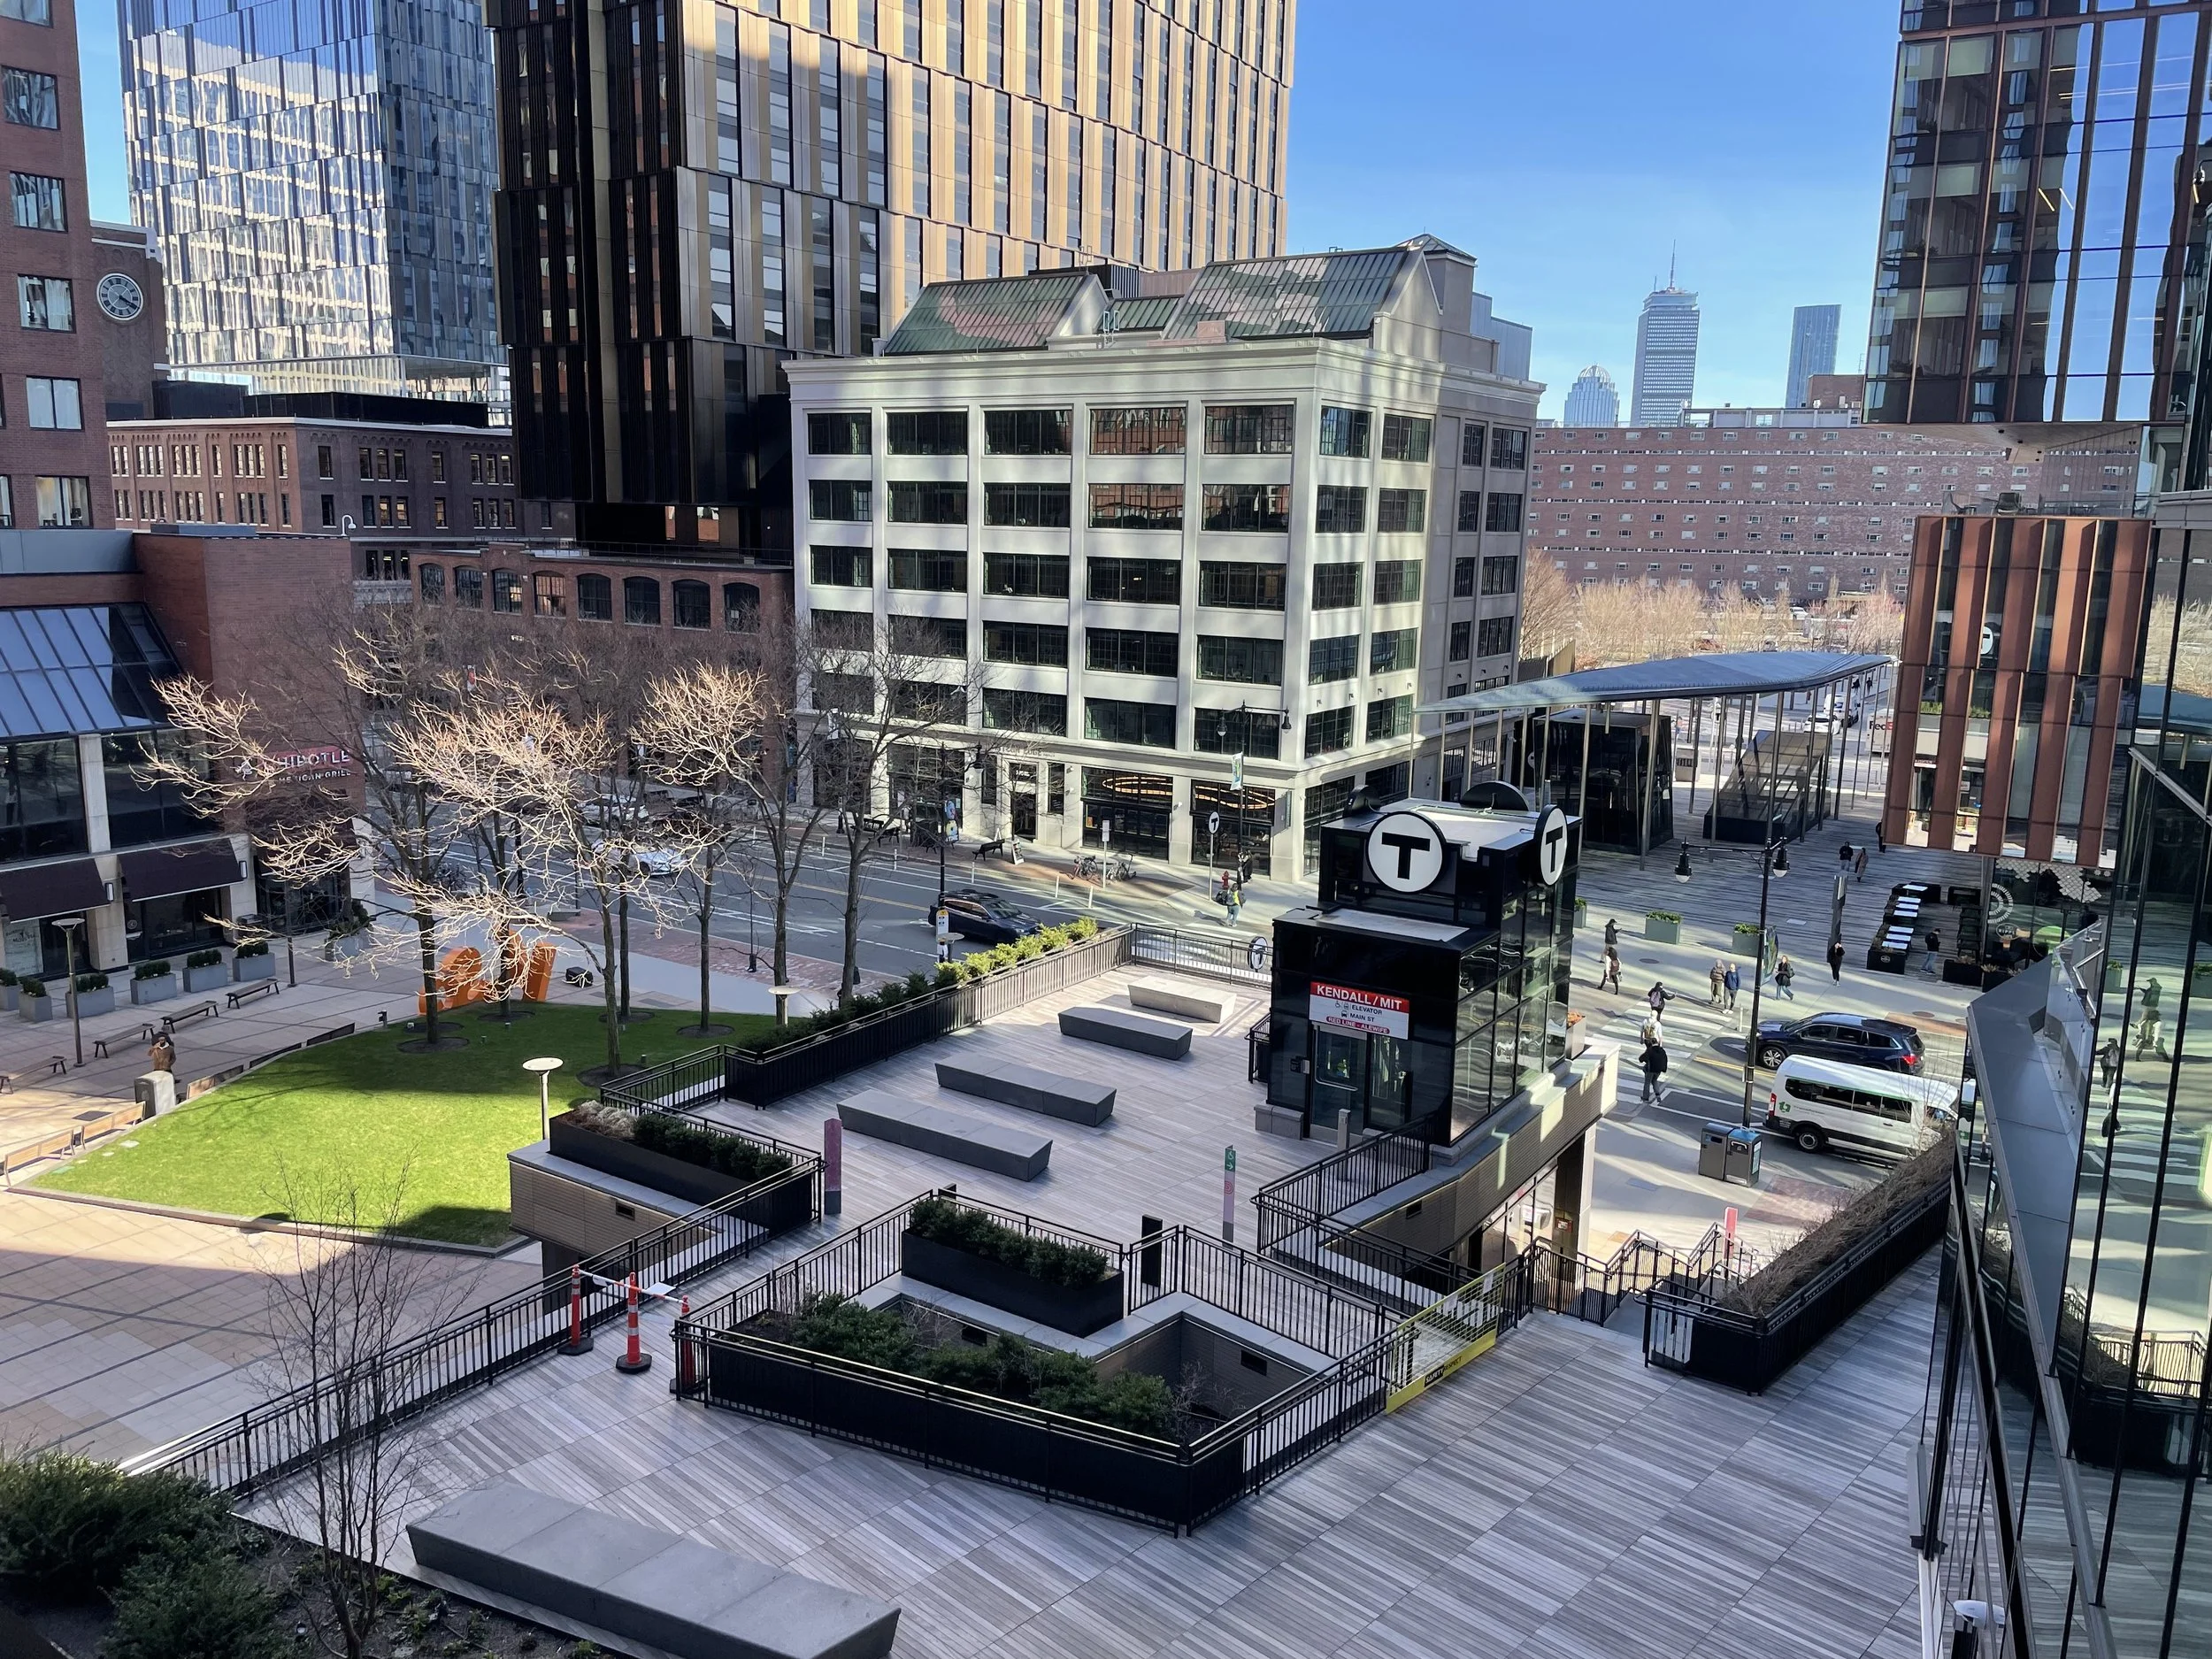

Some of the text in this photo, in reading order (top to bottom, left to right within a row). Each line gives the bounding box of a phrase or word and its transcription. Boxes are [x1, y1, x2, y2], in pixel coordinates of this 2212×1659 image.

[1869, 721, 1893, 730] FedE
[268, 749, 351, 770] HIPOTLE
[279, 769, 351, 784] MEICAN GRILL
[1210, 818, 1218, 830] T
[1381, 832, 1431, 879] T
[1546, 826, 1563, 872] T
[1317, 985, 1371, 1005] KENDALL
[1380, 997, 1402, 1010] MIT
[1351, 1005, 1383, 1016] ELEVATOR
[1361, 1024, 1388, 1034] ALEWIFE
